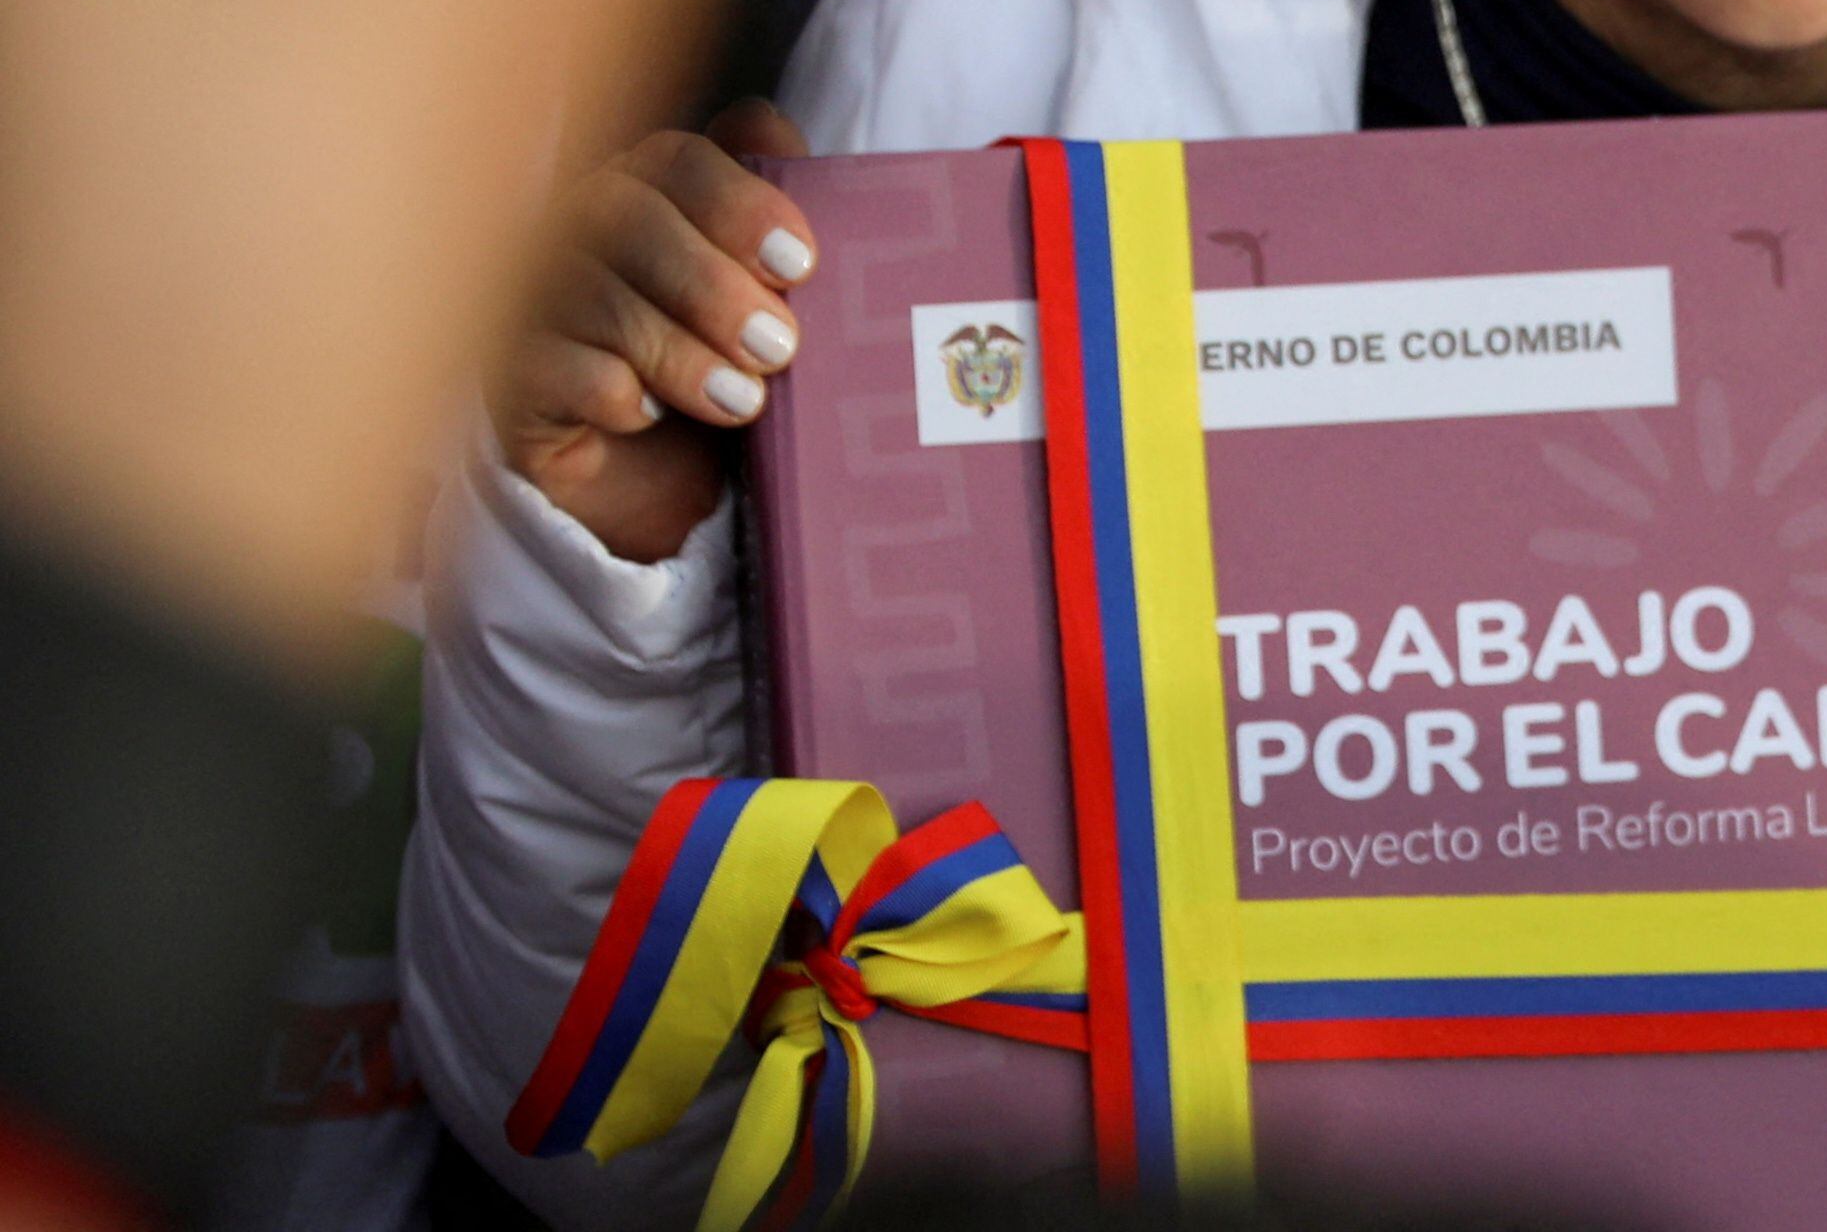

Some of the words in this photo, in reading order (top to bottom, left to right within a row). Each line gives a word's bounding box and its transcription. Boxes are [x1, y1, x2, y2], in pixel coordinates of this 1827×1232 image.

[1200, 338, 1317, 372] ERNO
[1331, 334, 1386, 365] DE
[1400, 322, 1621, 361] COLOMBIA
[1214, 585, 1754, 701] TRABAJO
[1236, 709, 1482, 807] POR
[1502, 699, 1640, 789] EL
[1251, 822, 1481, 878] Proyecto
[1496, 812, 1559, 858] de
[1576, 800, 1795, 851] Reforma
